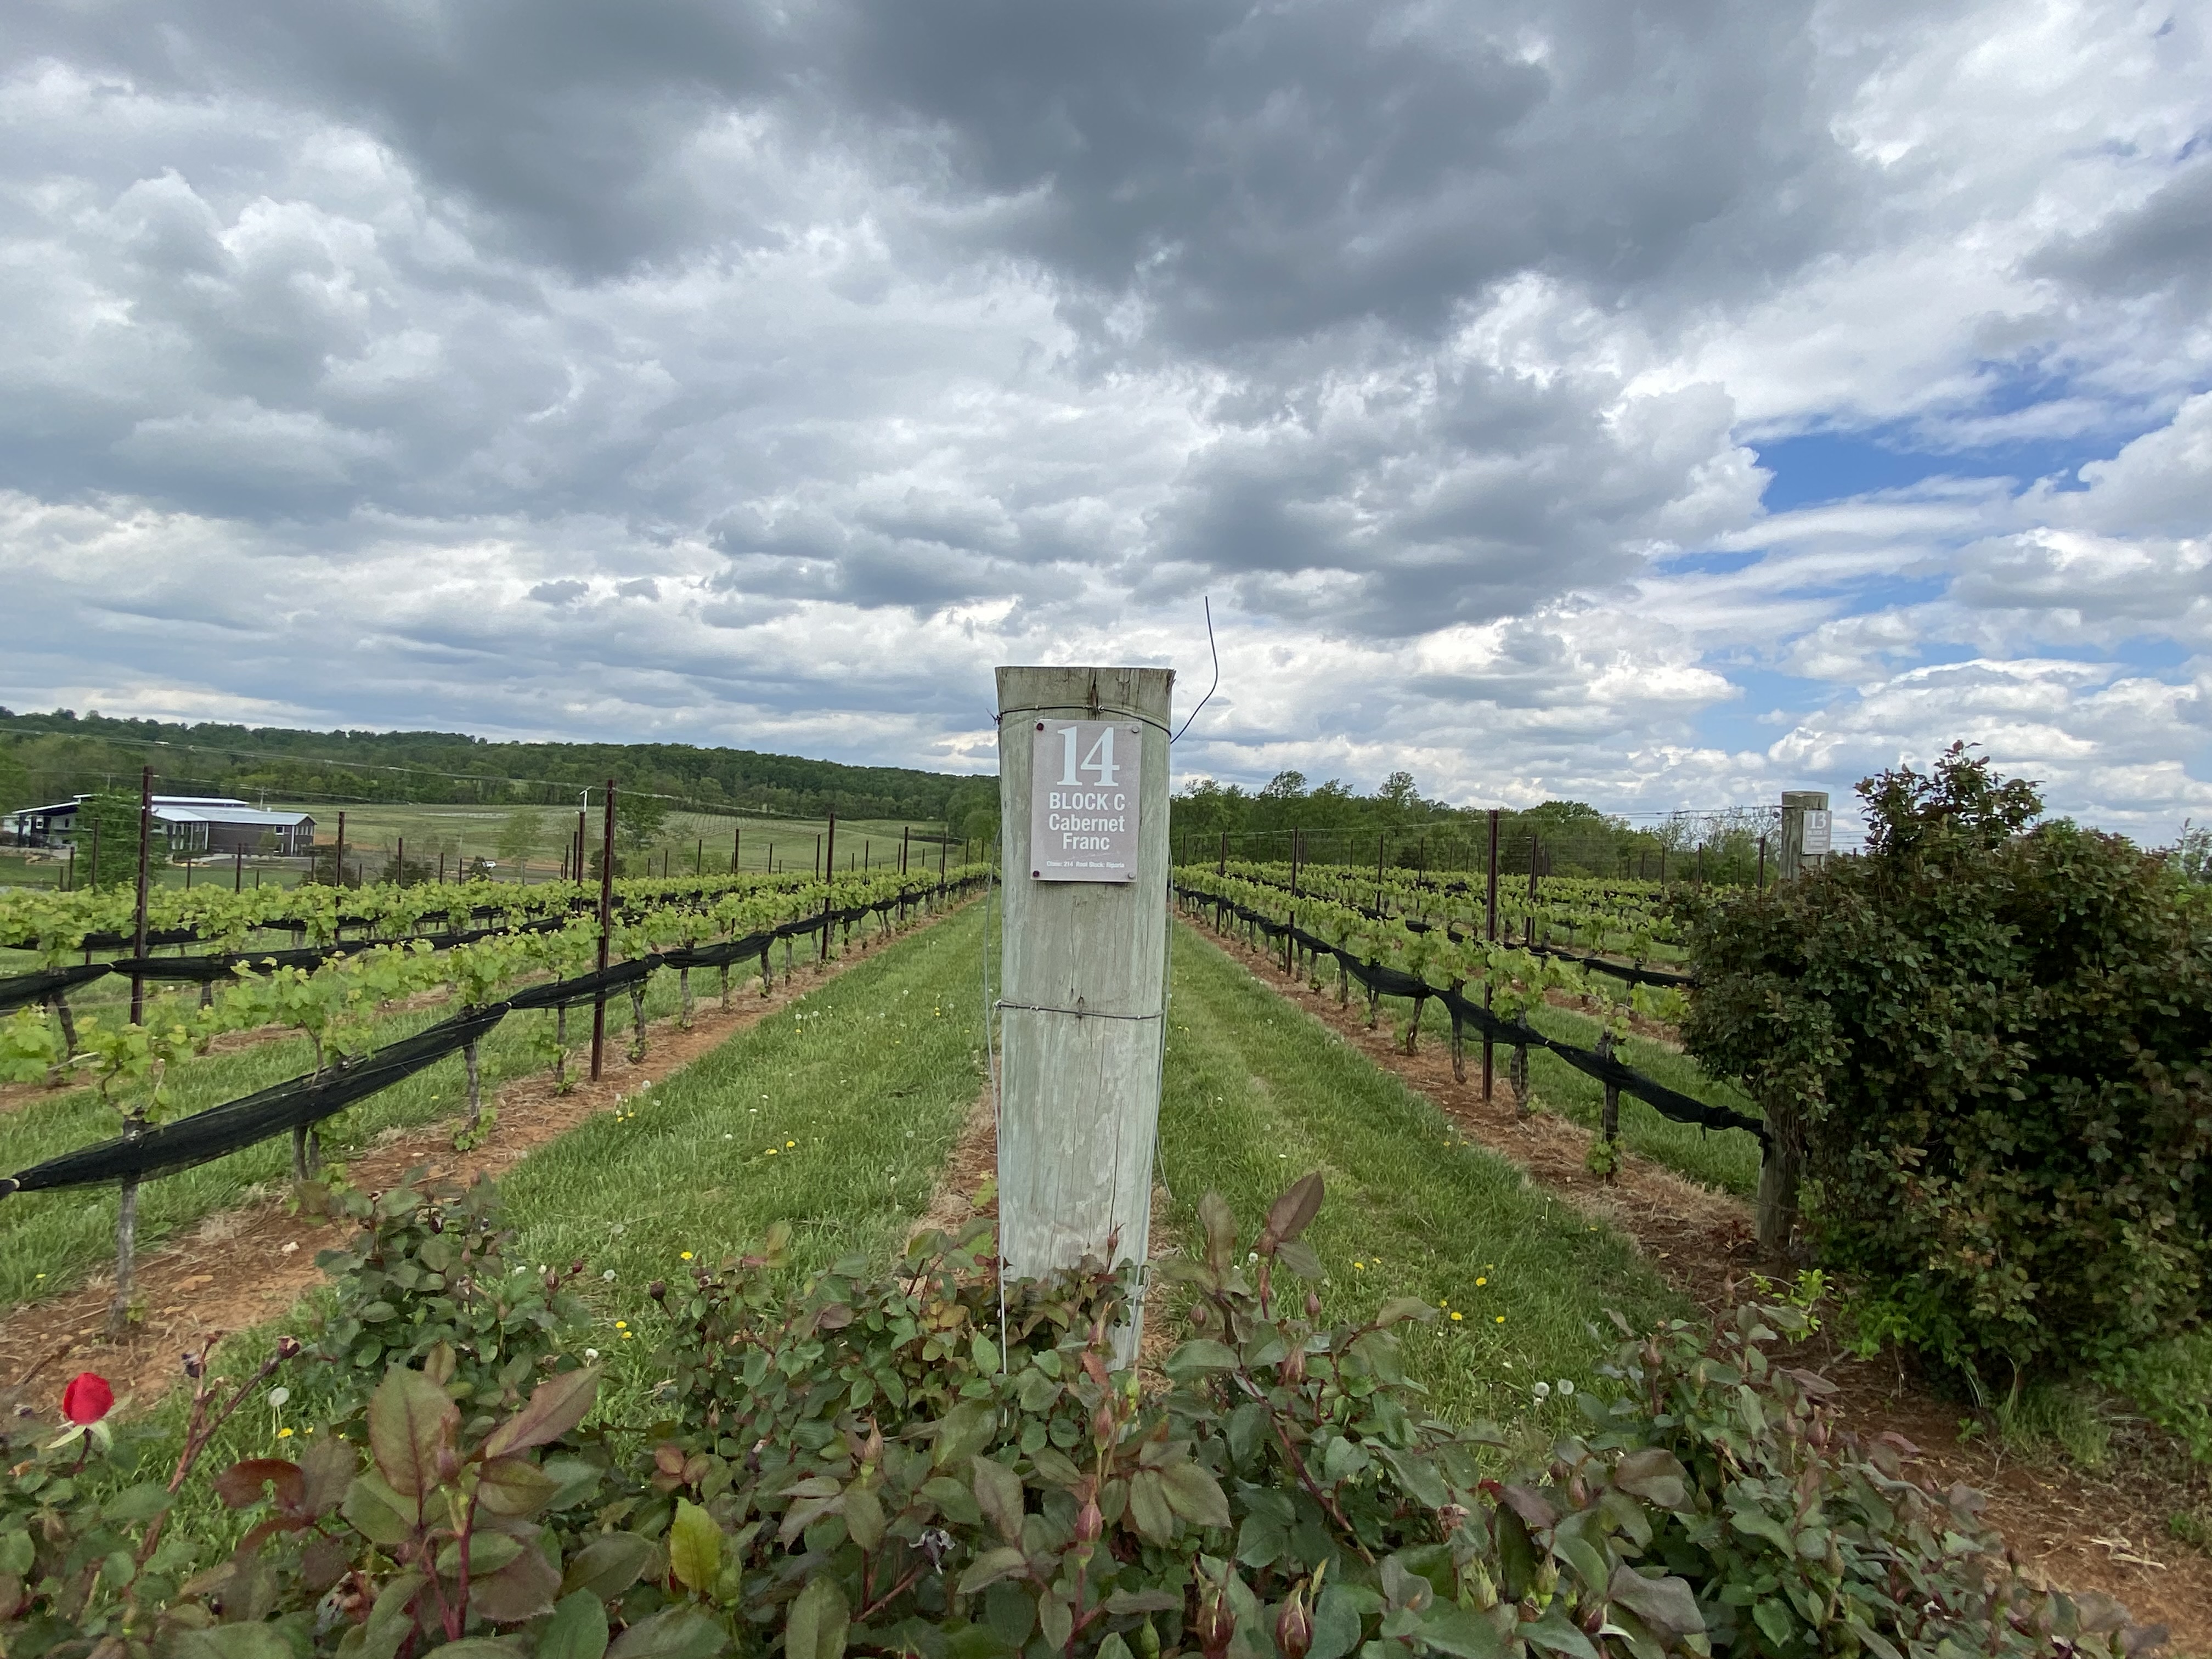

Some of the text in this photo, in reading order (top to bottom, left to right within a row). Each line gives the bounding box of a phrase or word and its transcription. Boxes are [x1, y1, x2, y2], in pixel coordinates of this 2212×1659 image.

[1057, 726, 1120, 787] 14
[1049, 792, 1126, 811] BLOCK C
[1048, 814, 1125, 832] Cabernet
[1810, 812, 1826, 829] 13
[1062, 833, 1110, 850] Franc
